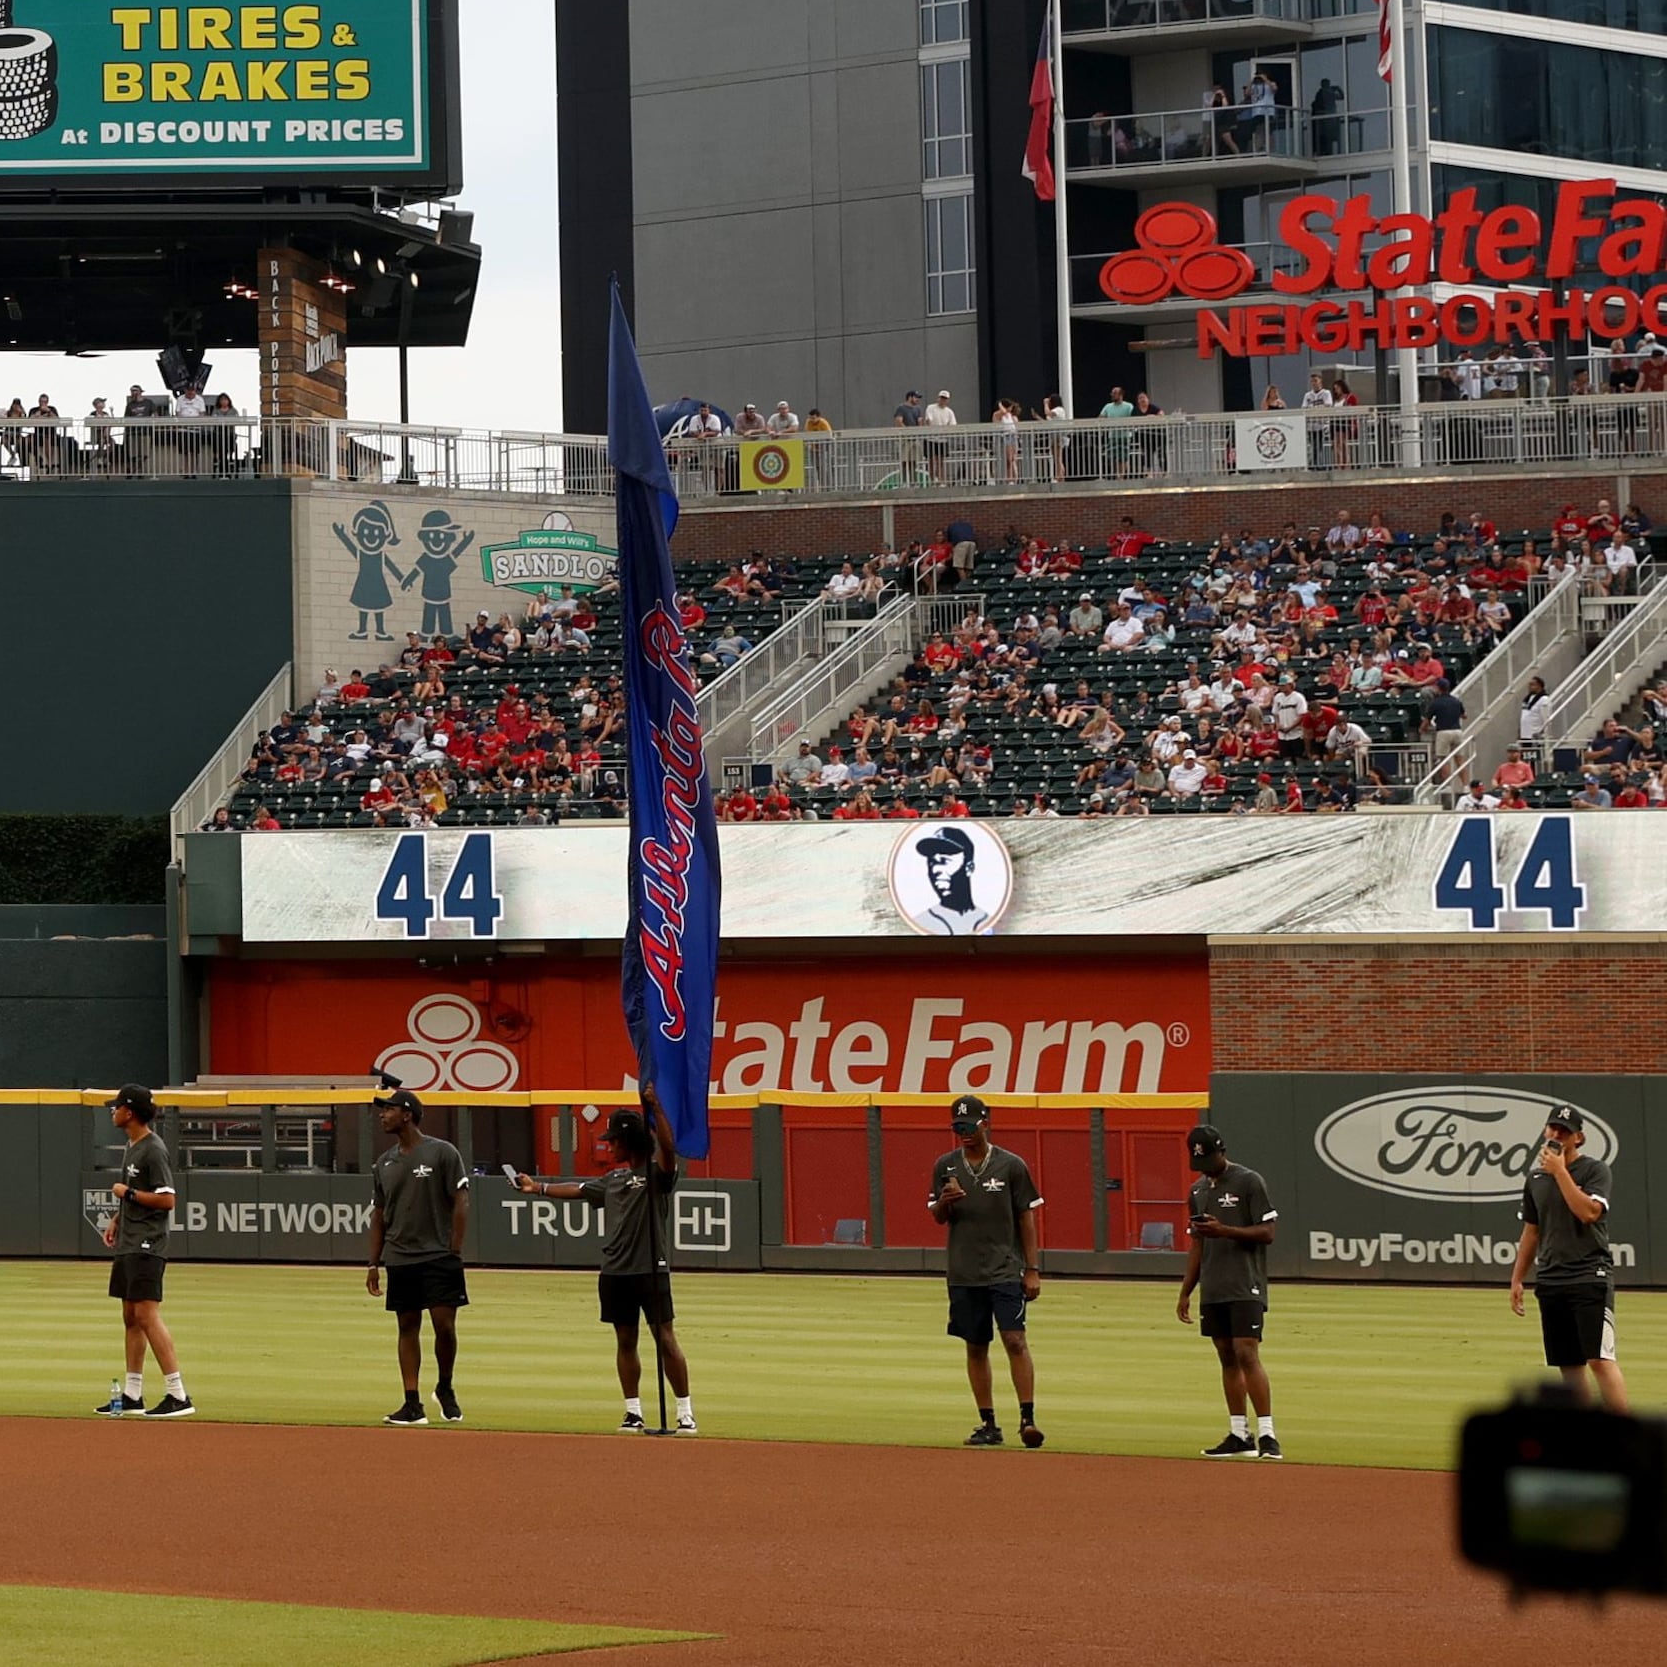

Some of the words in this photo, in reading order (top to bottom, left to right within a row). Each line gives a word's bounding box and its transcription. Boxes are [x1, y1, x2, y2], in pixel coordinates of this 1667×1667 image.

[111, 5, 322, 52] TIRES
[330, 23, 358, 48] &
[101, 58, 371, 103] BRAKES
[61, 127, 89, 146] At
[99, 119, 271, 145] DISCOUNT
[284, 117, 405, 144] PRICES
[270, 260, 280, 328] BACK
[271, 341, 280, 416] PORCH
[526, 536, 549, 545] Hope
[550, 535, 566, 544] and
[726, 766, 740, 775] 153
[375, 831, 505, 937] 44
[1433, 814, 1588, 931] 44
[1376, 1106, 1547, 1179] Ford
[169, 1201, 208, 1232] LB
[219, 1202, 376, 1234] NETWORK
